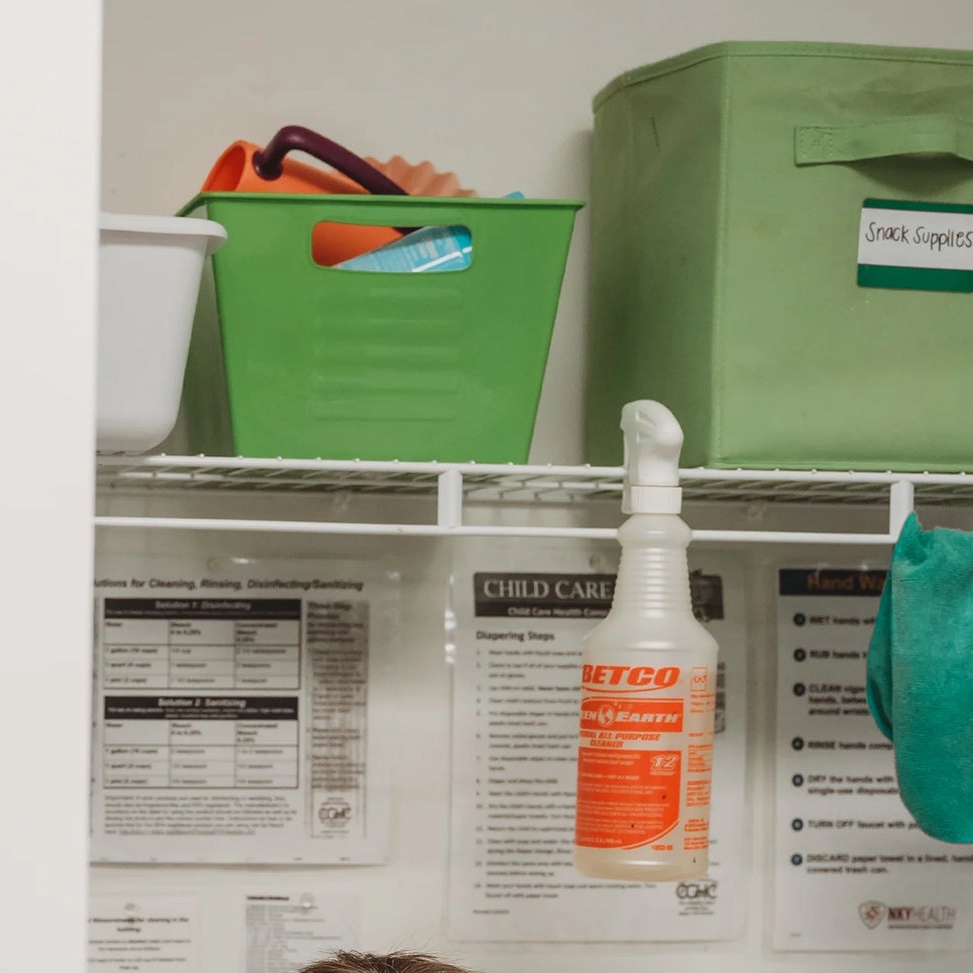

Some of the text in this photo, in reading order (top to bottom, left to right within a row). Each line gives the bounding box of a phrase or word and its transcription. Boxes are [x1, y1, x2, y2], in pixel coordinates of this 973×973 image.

[865, 221, 973, 251] Snack Supplies
[806, 573, 853, 589] Hand
[483, 579, 612, 600] CHILD CARE
[476, 631, 555, 642] Diapering Steps
[582, 665, 681, 686] BETCO
[616, 711, 679, 723] EARTH
[590, 740, 624, 748] CLEANER
[615, 733, 661, 741] PURPOSE
